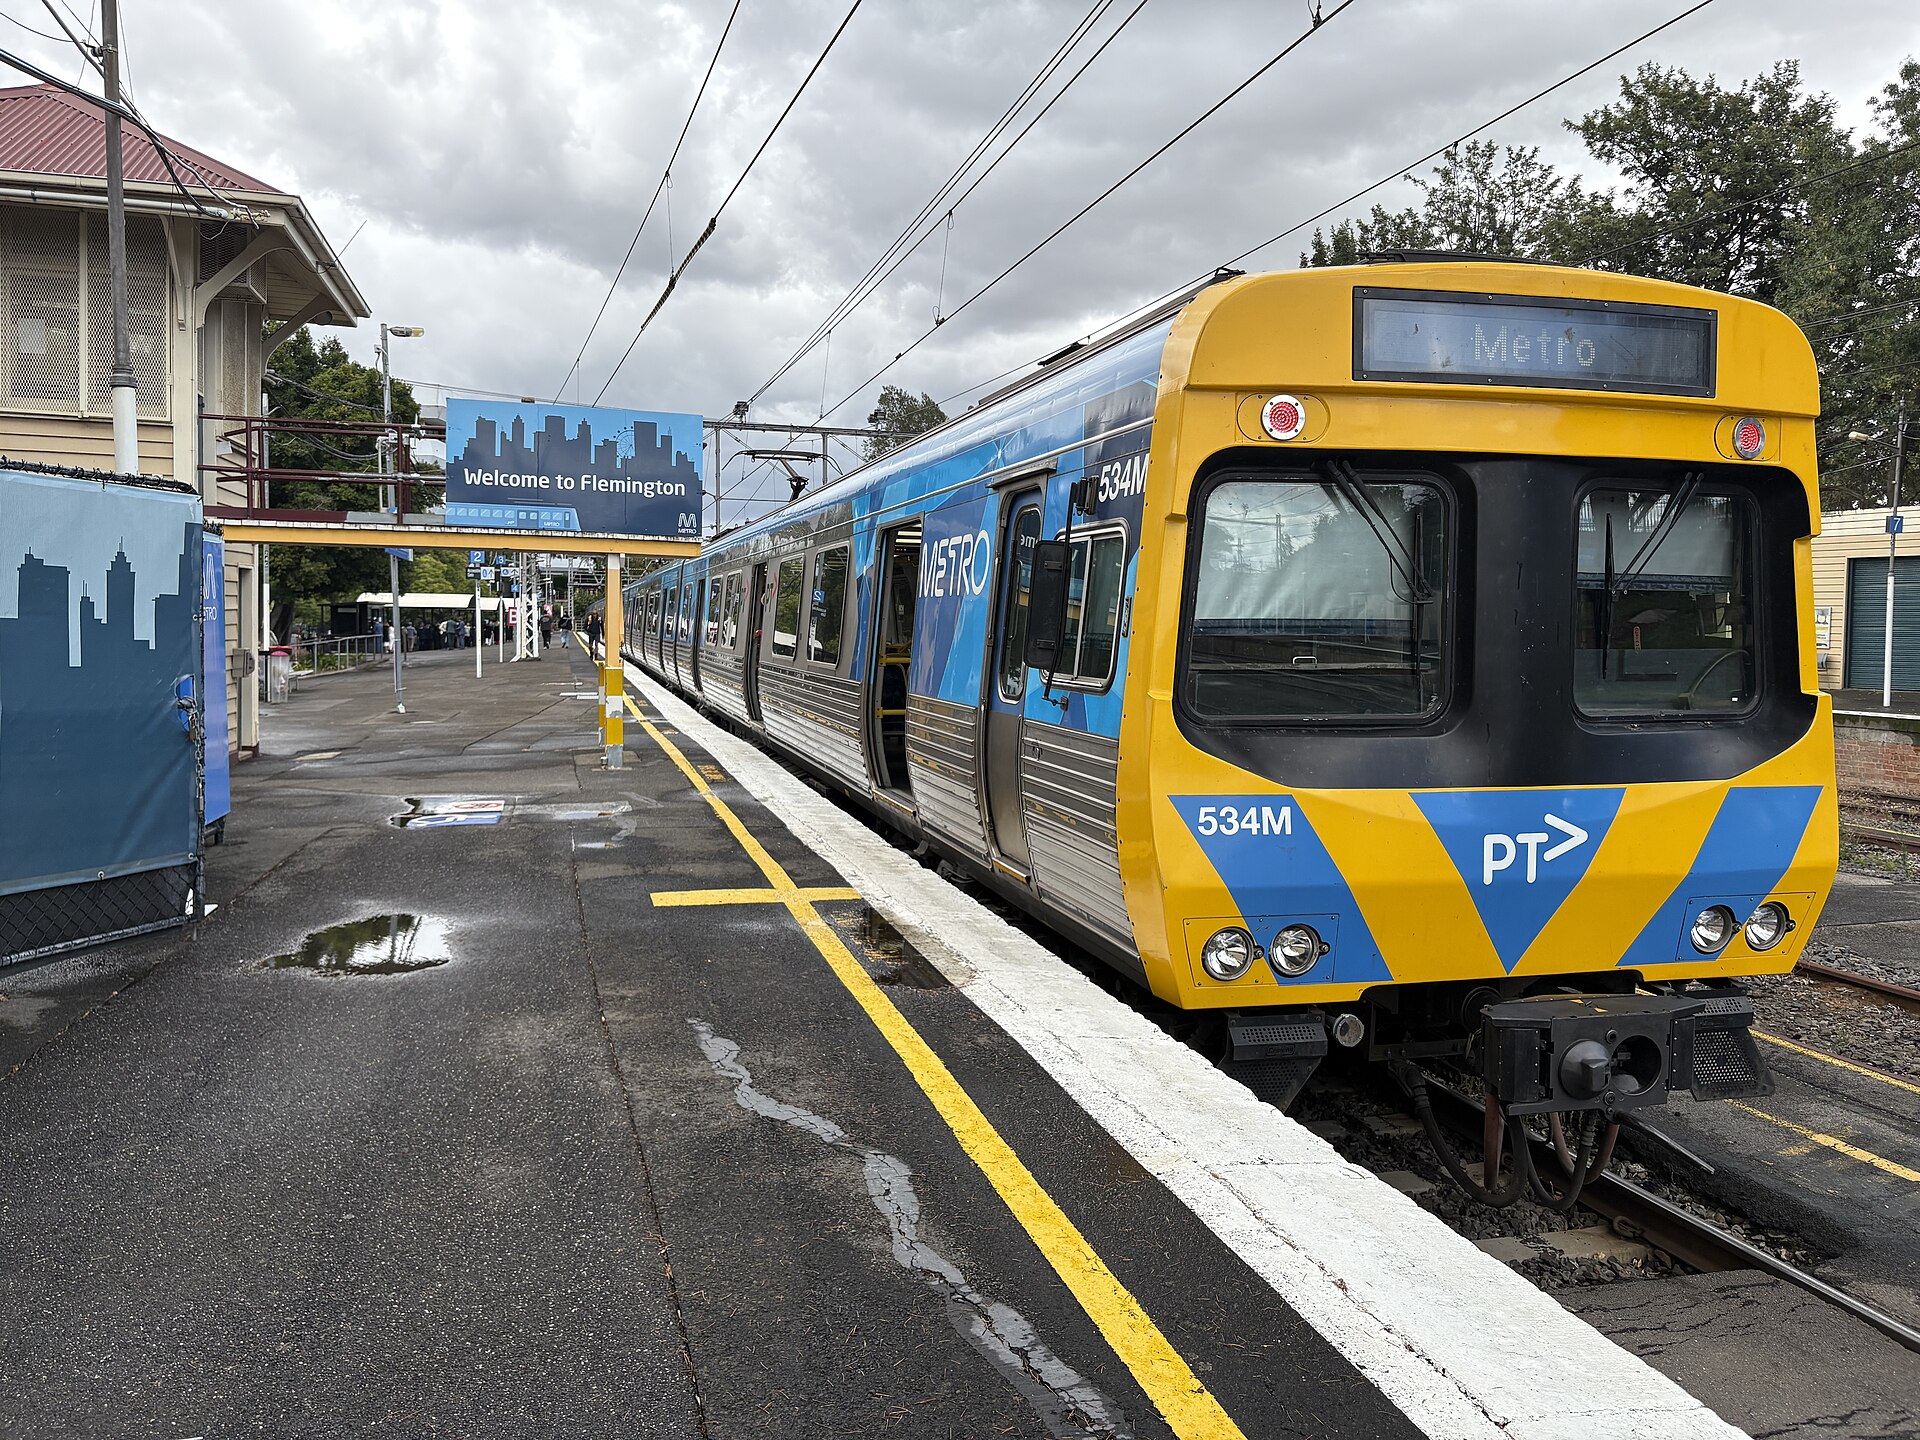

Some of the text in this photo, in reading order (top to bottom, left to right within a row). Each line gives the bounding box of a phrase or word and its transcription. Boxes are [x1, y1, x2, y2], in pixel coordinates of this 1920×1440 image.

[1473, 323, 1596, 367] Metro
[464, 468, 686, 498] Welcome to Flemington
[1098, 453, 1150, 503] 534M
[1893, 517, 1901, 531] 7
[473, 552, 482, 562] 2
[498, 556, 503, 565] 3
[918, 530, 990, 598] METRO
[1197, 806, 1292, 836] 534M
